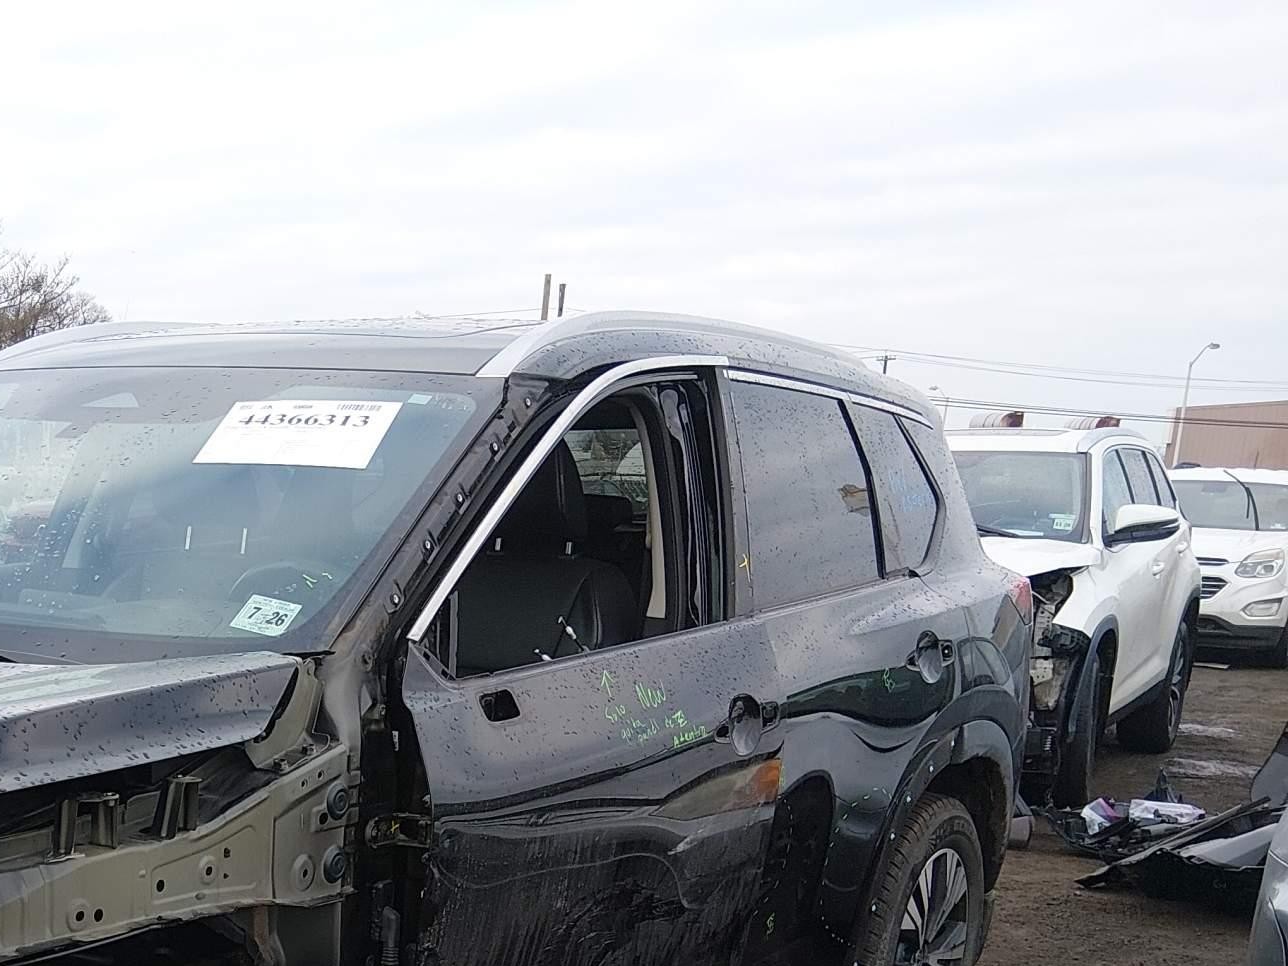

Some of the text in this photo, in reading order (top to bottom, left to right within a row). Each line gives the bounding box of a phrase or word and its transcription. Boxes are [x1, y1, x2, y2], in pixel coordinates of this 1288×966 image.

[239, 413, 370, 427] 44366313
[247, 606, 289, 627] 7 26
